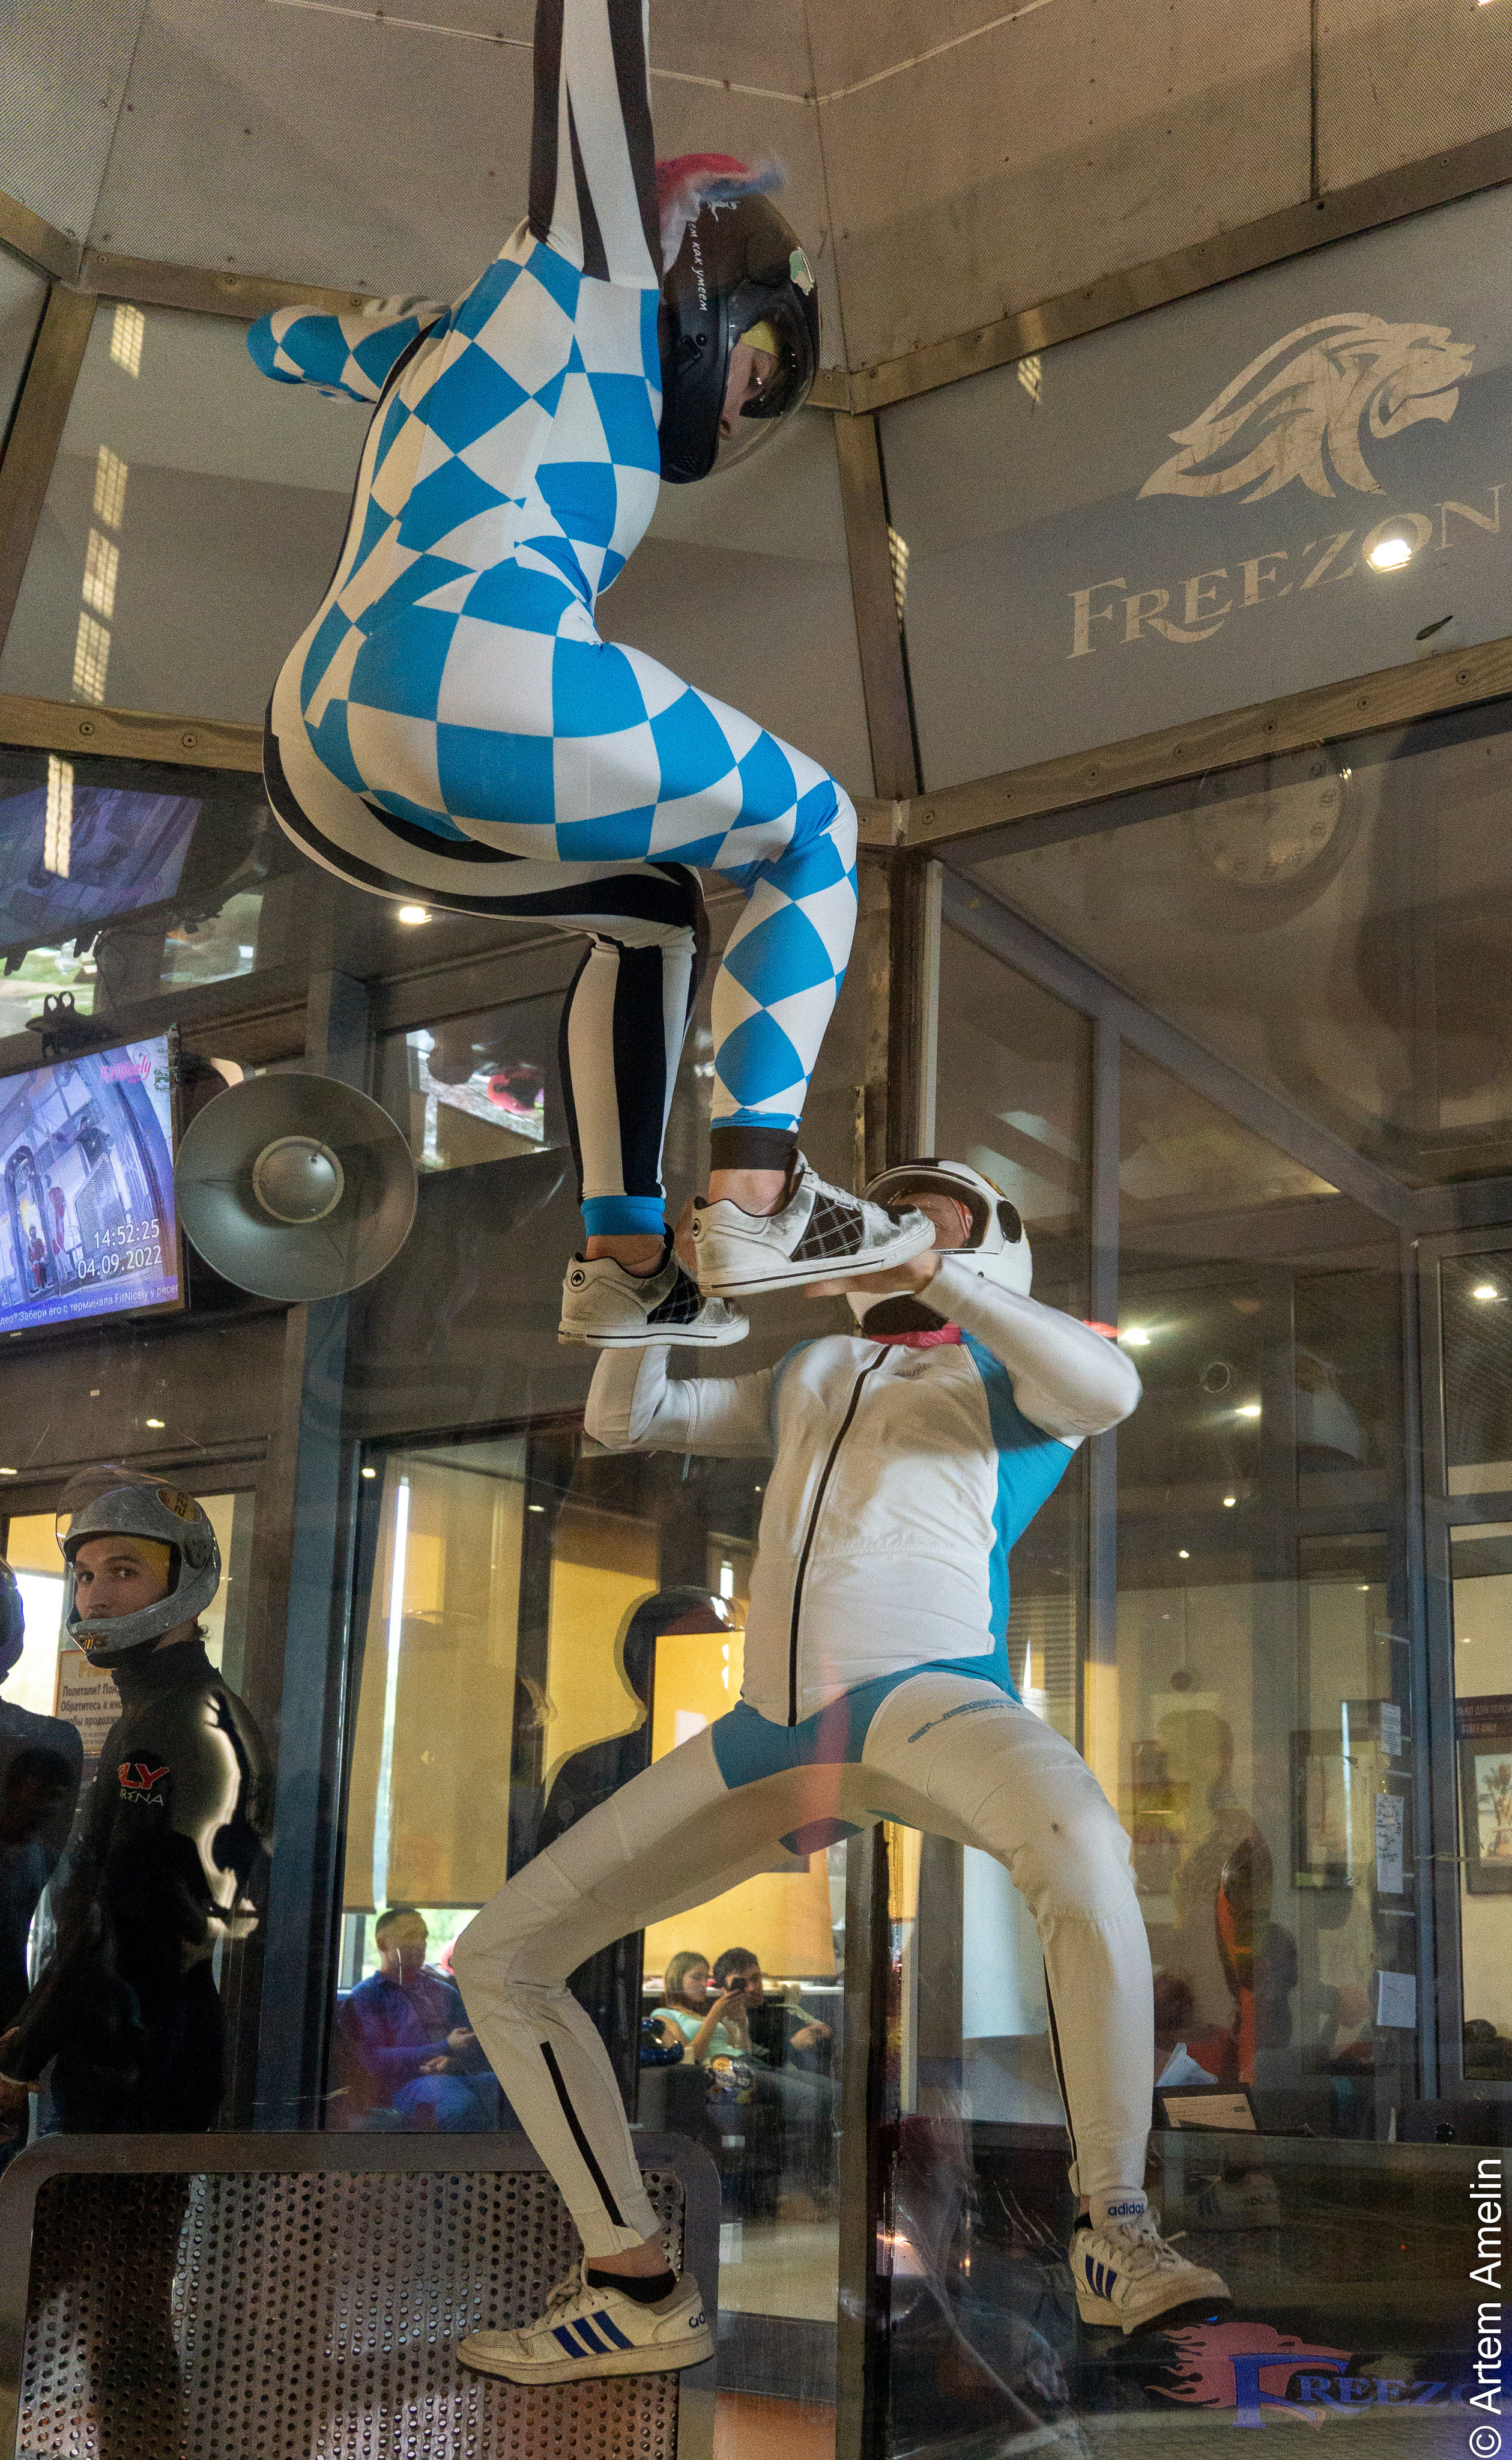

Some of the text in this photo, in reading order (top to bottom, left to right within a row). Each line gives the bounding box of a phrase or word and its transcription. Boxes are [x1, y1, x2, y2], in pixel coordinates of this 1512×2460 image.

[688, 222, 707, 311] ем как умеем
[1066, 483, 1506, 659] FREEZON
[94, 1219, 160, 1249] 14:52:25
[78, 1245, 162, 1279] 04.09.2022
[19, 1308, 47, 1322] Забери
[49, 1305, 61, 1316] его
[71, 1297, 113, 1313] терминала
[115, 1288, 148, 1303] FitNicely
[61, 1700, 101, 1714] Обратитесь
[1108, 2201, 1145, 2216] adidas
